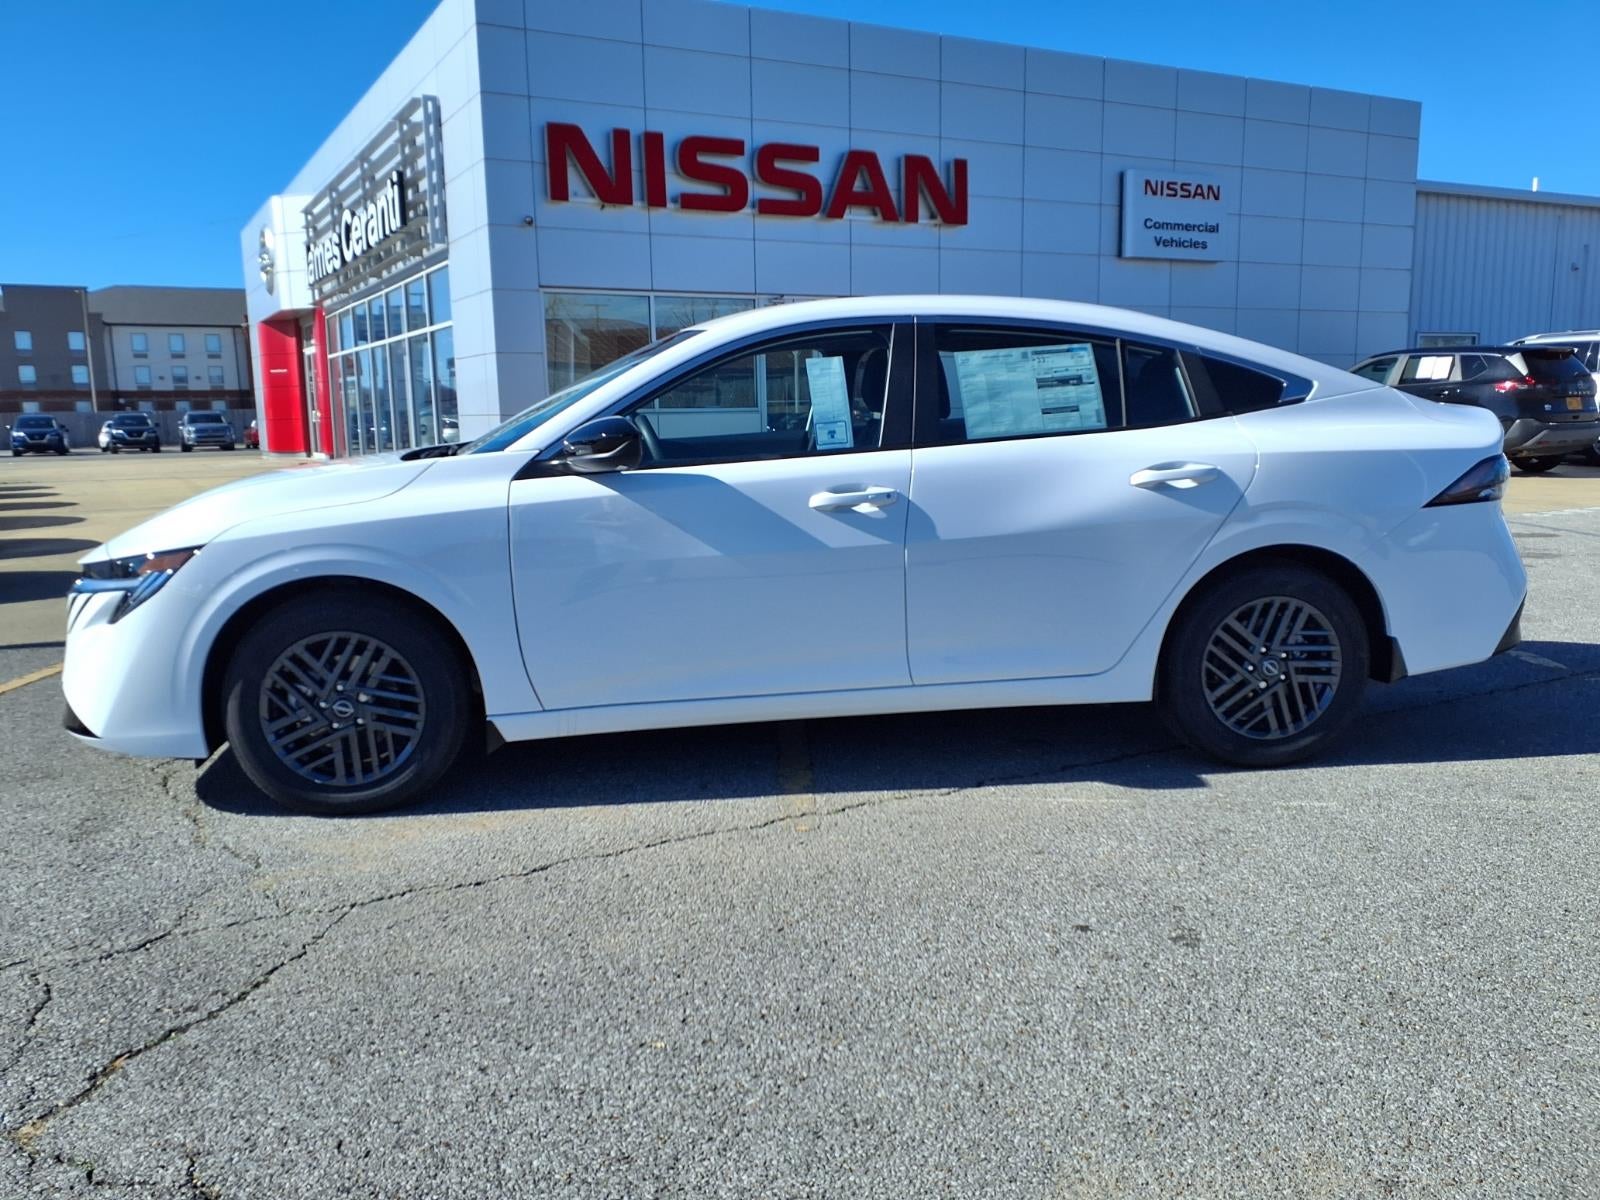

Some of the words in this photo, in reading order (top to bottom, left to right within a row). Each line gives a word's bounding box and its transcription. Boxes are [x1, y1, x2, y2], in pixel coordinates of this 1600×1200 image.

[545, 122, 968, 226] NISSAN
[1144, 179, 1221, 201] NISSAN
[307, 232, 341, 285] ames
[341, 170, 401, 262] Ceranti
[1143, 218, 1219, 233] Commercial
[1153, 235, 1208, 250] Vehicles
